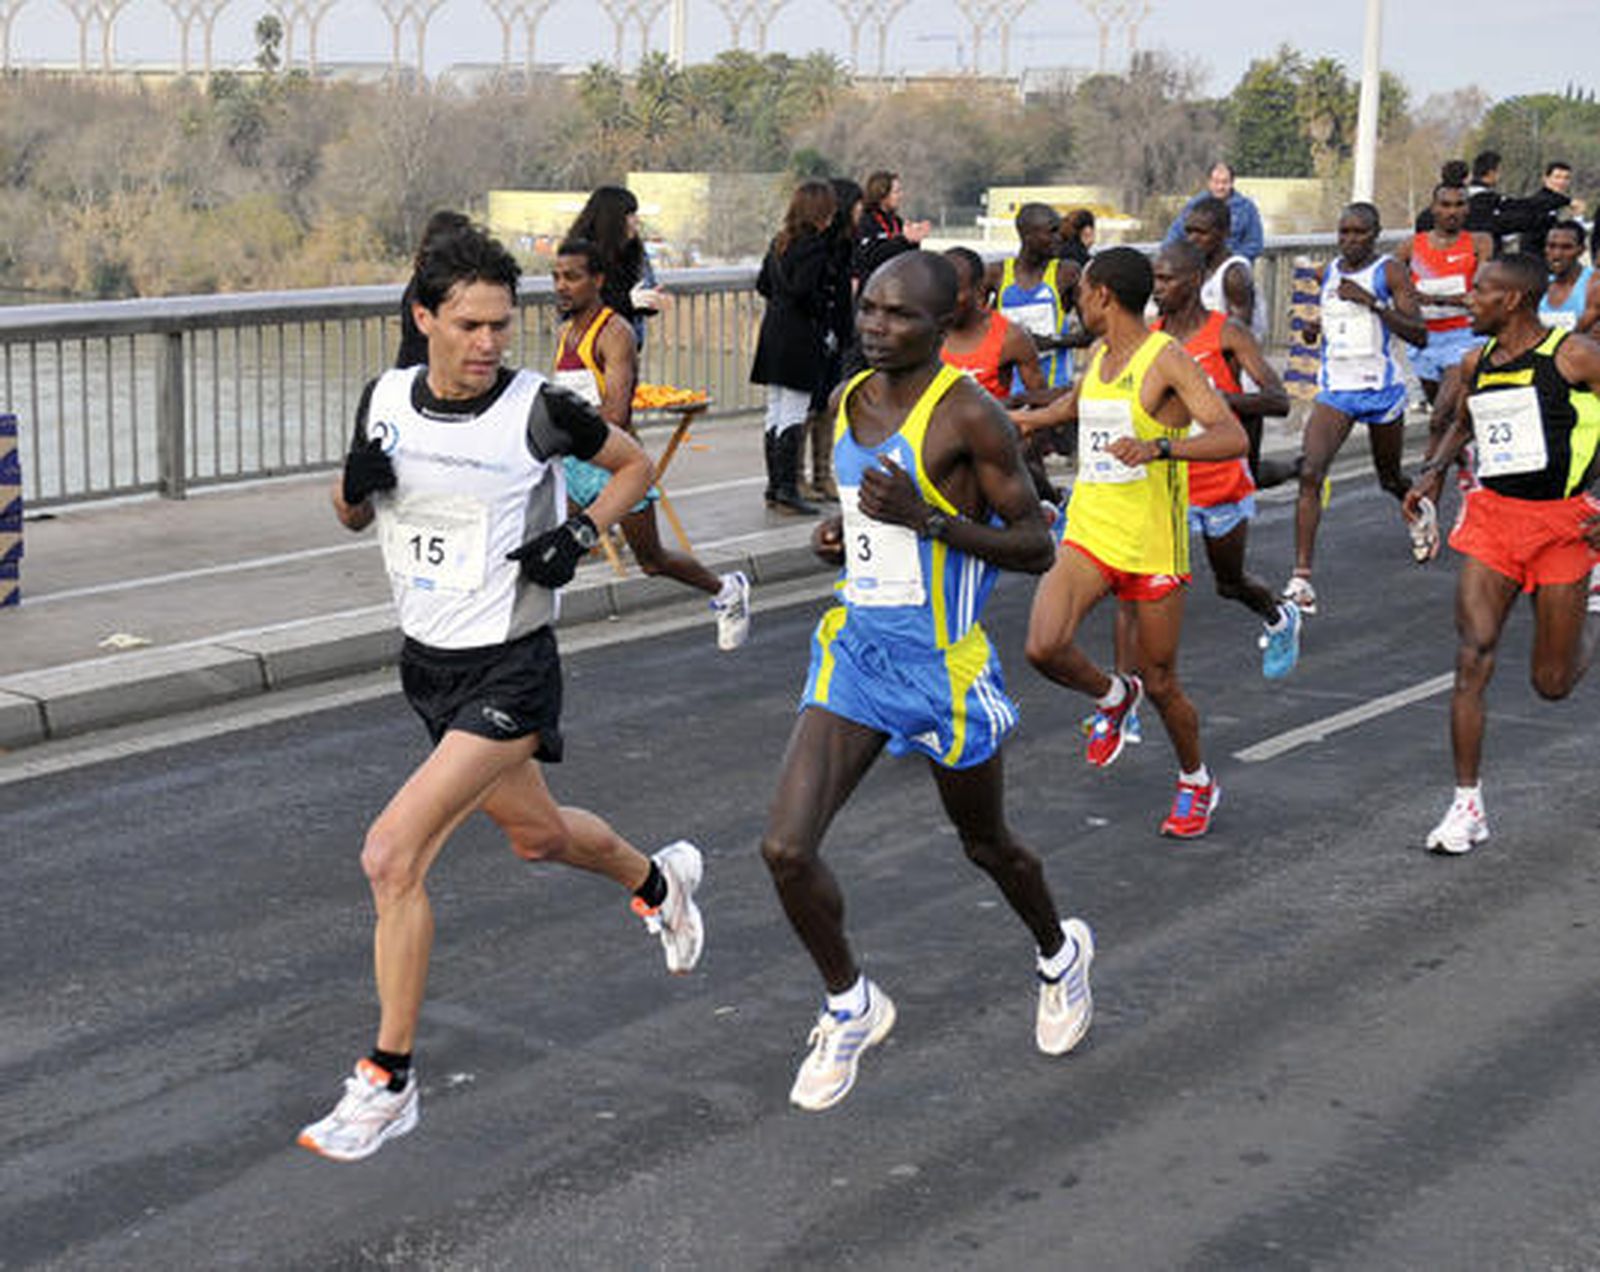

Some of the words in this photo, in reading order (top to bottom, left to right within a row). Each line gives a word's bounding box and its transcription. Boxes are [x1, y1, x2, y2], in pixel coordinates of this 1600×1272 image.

[1487, 422, 1512, 445] 23
[409, 533, 446, 566] 15
[857, 532, 872, 562] 3
